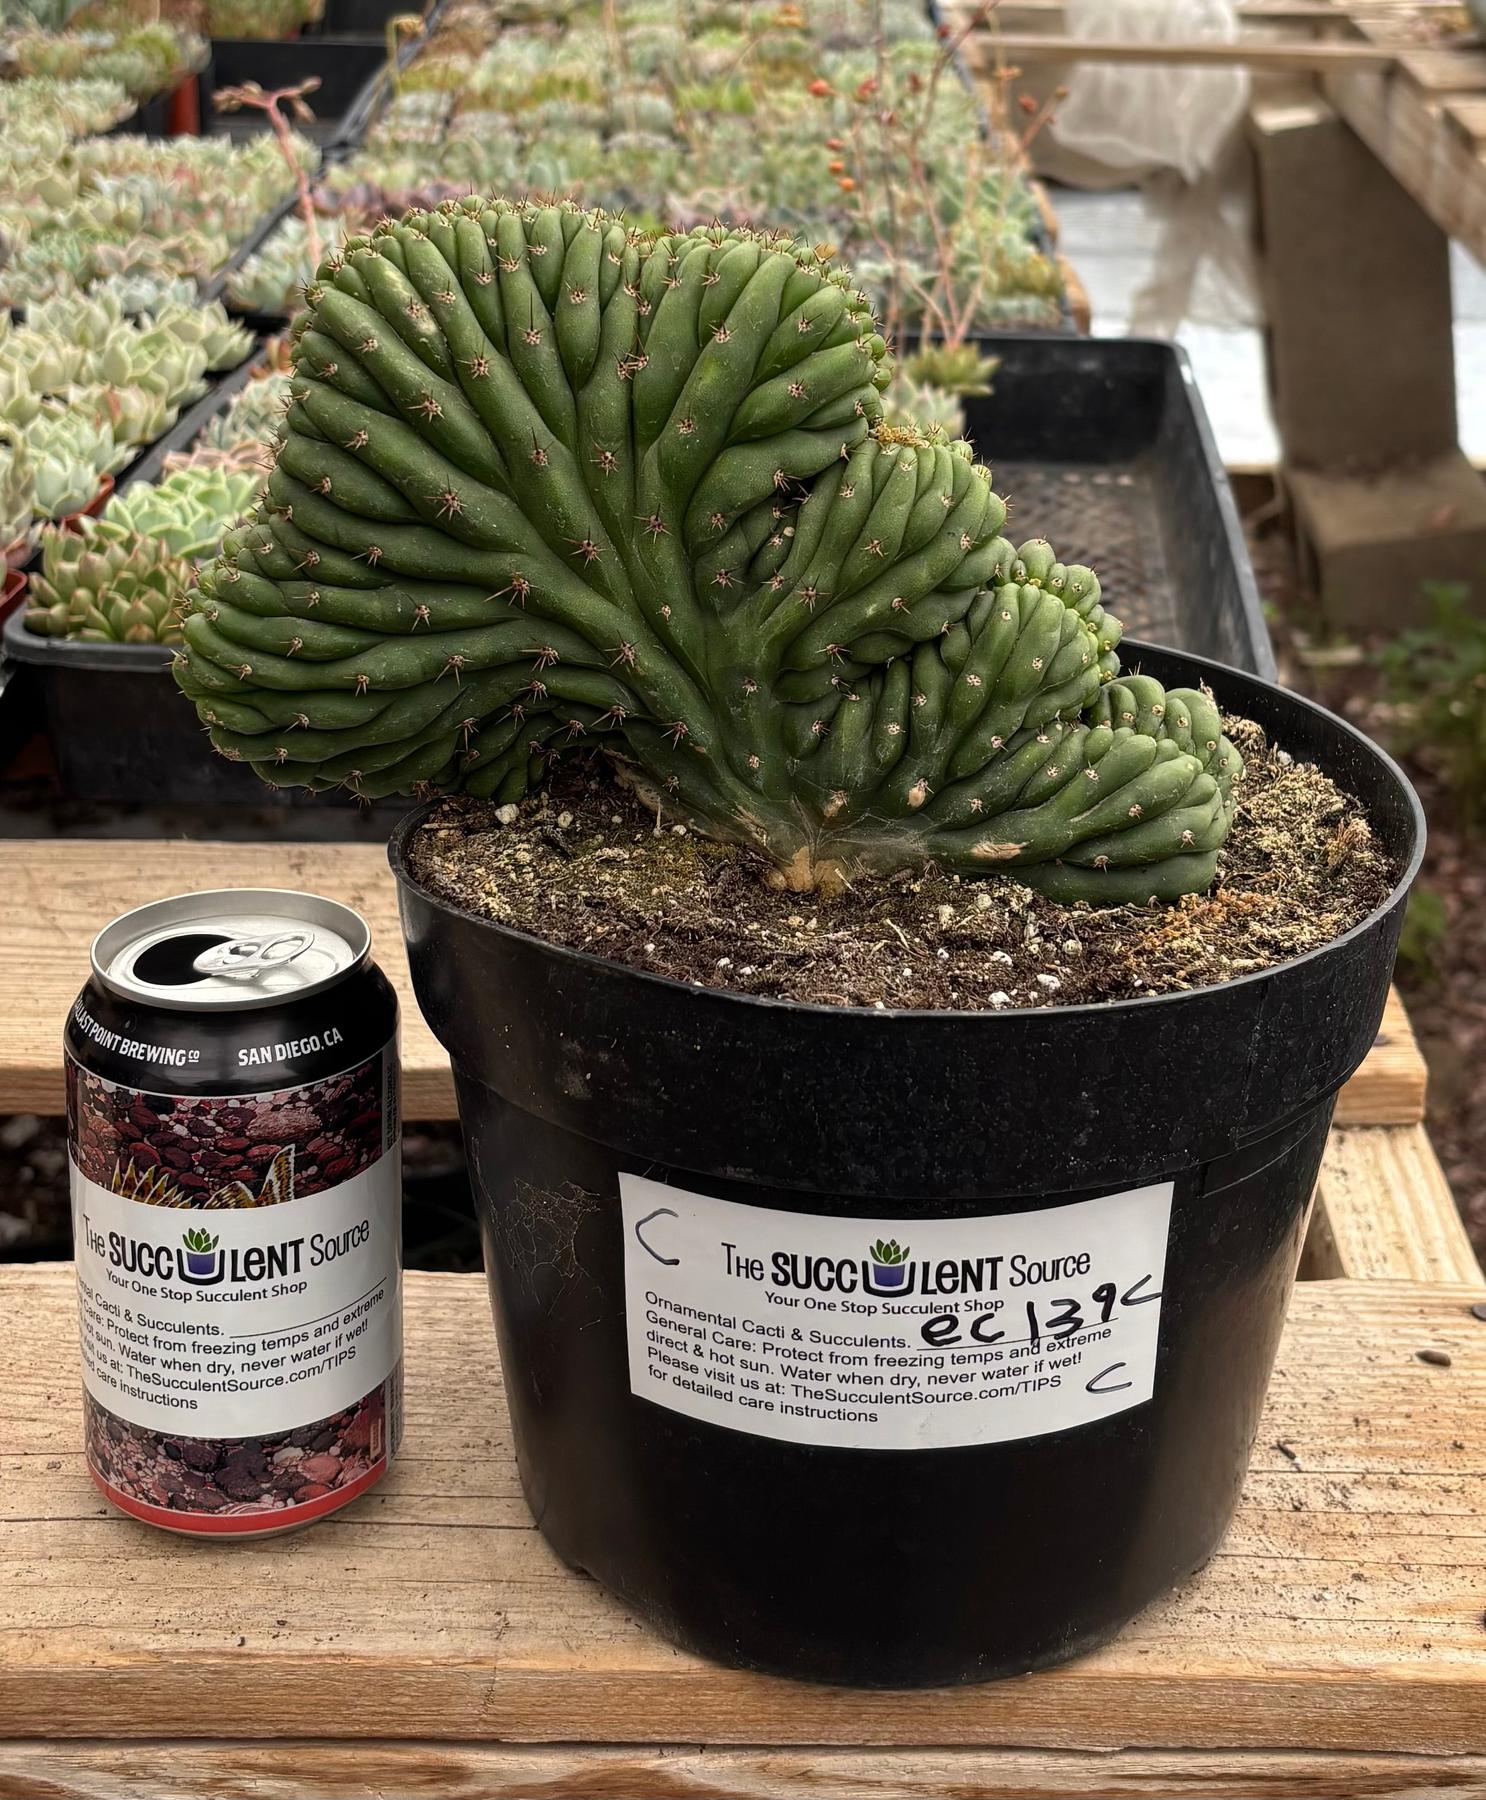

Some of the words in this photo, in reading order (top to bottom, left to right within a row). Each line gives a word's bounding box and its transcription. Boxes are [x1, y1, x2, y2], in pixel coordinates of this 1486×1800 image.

[88, 1021, 122, 1052] POINT
[119, 1037, 187, 1067] BREWING
[237, 1047, 273, 1067] SAN
[324, 1027, 344, 1048] CA
[309, 1218, 370, 1267] Source
[105, 1267, 130, 1289] Your
[131, 1280, 158, 1297] One
[160, 1286, 193, 1304] Stop
[195, 1287, 269, 1303] Succulent
[271, 1279, 308, 1299] Shop
[1008, 1251, 1092, 1288] Source
[95, 1292, 121, 1318] Cacti
[124, 1308, 133, 1323] &
[137, 1313, 225, 1337] Succulents.
[107, 1318, 150, 1347] Protect
[152, 1335, 187, 1353] from
[191, 1340, 257, 1356] freezing
[261, 1329, 310, 1355] temps
[313, 1319, 340, 1339] and
[342, 1288, 385, 1326] extreme
[645, 1290, 737, 1330] Ornamental
[741, 1319, 786, 1340] Cacti
[790, 1327, 803, 1342] &
[808, 1330, 912, 1349] Succulents.
[764, 1290, 801, 1308] Your
[803, 1298, 837, 1312] One
[841, 1300, 878, 1317] Stop
[881, 1301, 961, 1315] Succulent
[963, 1298, 1005, 1314] Shop
[95, 1331, 116, 1352] sun.
[118, 1341, 157, 1366] Water
[160, 1357, 202, 1374] when
[206, 1360, 236, 1377] dry,
[240, 1356, 287, 1373] never
[290, 1341, 331, 1364] water
[334, 1332, 344, 1349] if
[345, 1318, 369, 1345] wet!
[645, 1310, 708, 1341] General
[712, 1330, 757, 1353] Care:
[762, 1342, 824, 1364] Protect
[828, 1351, 869, 1367] from
[873, 1352, 945, 1369] freezing
[950, 1350, 1004, 1368] temps
[1008, 1338, 1041, 1360] and
[1046, 1326, 1112, 1353] extreme
[645, 1328, 689, 1354] direct
[693, 1344, 705, 1359] &
[709, 1347, 735, 1367] hot
[739, 1358, 775, 1375] sun.
[780, 1363, 833, 1383] Water
[836, 1370, 884, 1386] when
[889, 1370, 921, 1388] dry,
[927, 1372, 978, 1386] never
[981, 1363, 1030, 1381] water
[1033, 1358, 1043, 1373] if
[1048, 1351, 1082, 1371] wet!
[96, 1349, 108, 1365] us
[110, 1358, 124, 1374] at:
[126, 1345, 357, 1393] TheSucculentSource.com/TIPS
[96, 1367, 118, 1388] care
[119, 1379, 199, 1411] instructions
[647, 1346, 700, 1375] Please
[703, 1365, 736, 1386] visit
[740, 1377, 760, 1391] us
[764, 1381, 786, 1396] at:
[791, 1374, 1063, 1406] TheSucculentSource.com/TIPS
[648, 1364, 668, 1383] for
[672, 1374, 734, 1403] detailed
[738, 1394, 775, 1412] care
[780, 1400, 879, 1423] instructions
